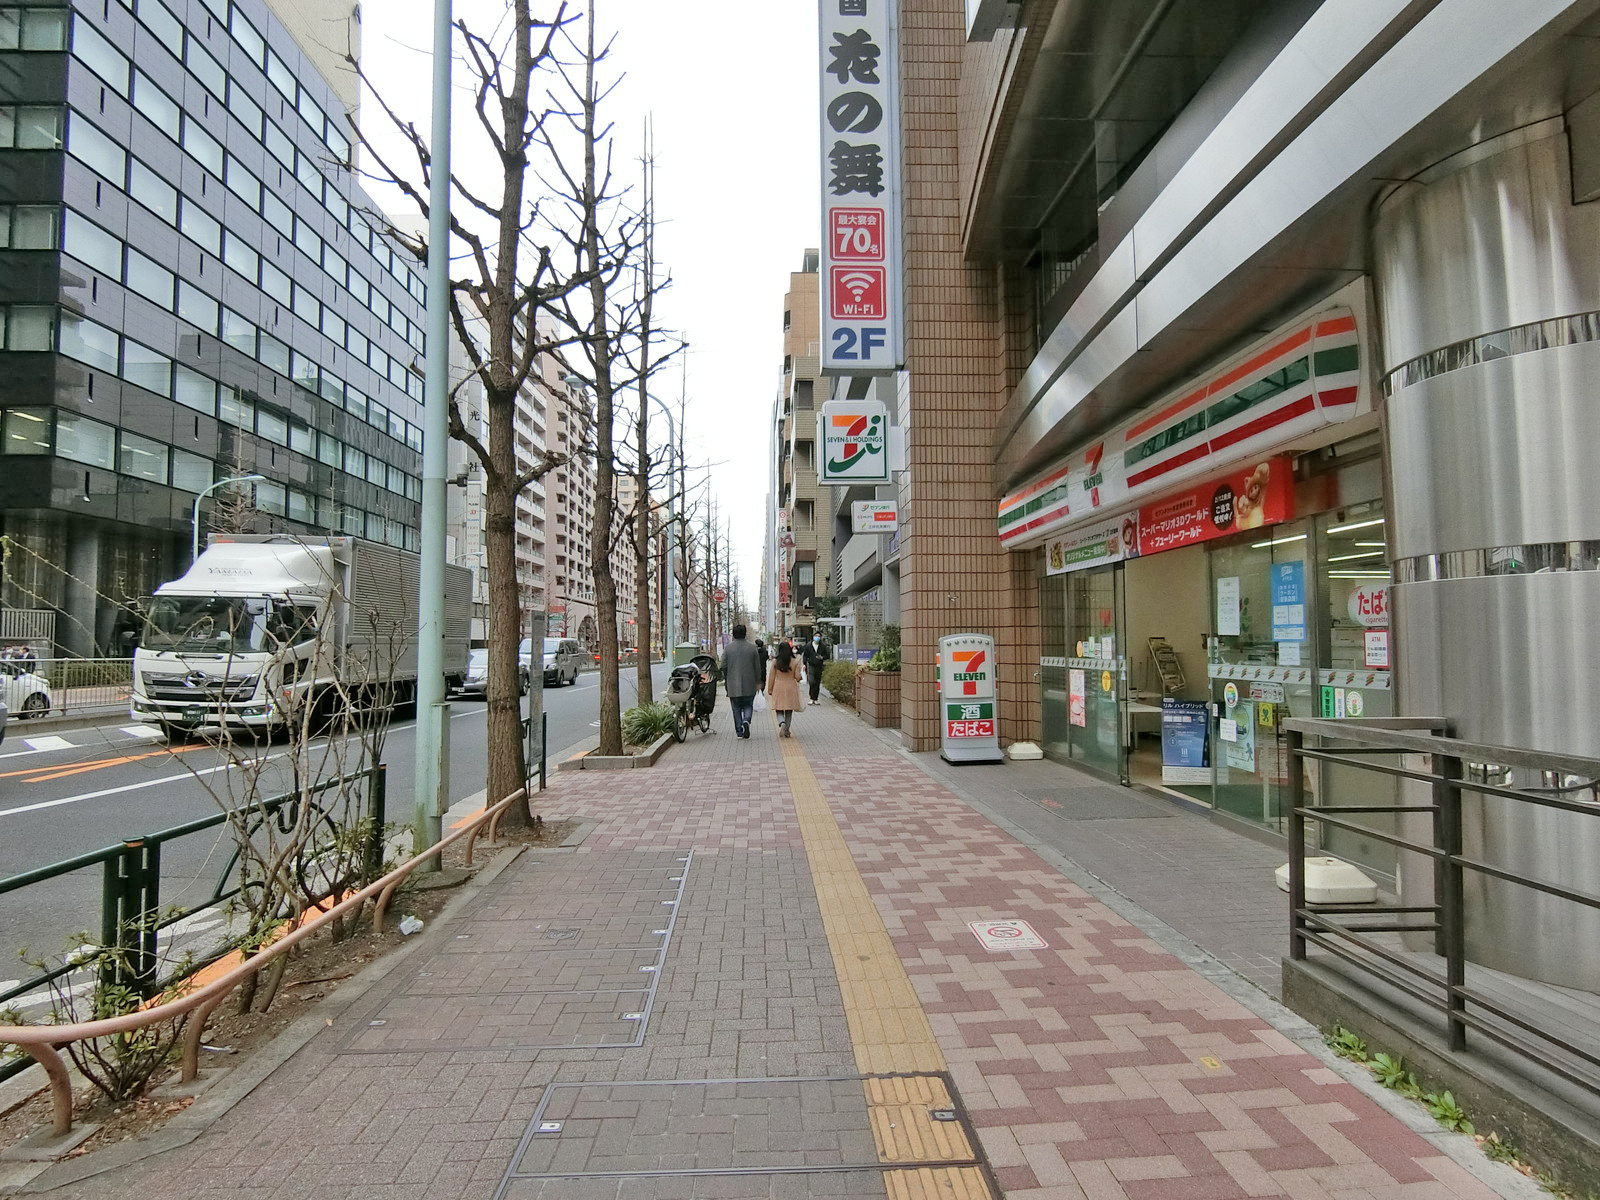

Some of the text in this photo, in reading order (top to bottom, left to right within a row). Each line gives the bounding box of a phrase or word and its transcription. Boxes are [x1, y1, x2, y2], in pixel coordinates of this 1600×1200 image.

[826, 29, 885, 198] 花の舞
[838, 215, 877, 226] 最大宴会
[831, 328, 887, 360] 2F
[1358, 589, 1388, 616] たば
[960, 704, 981, 719] 酒
[951, 721, 992, 737] たばこ
